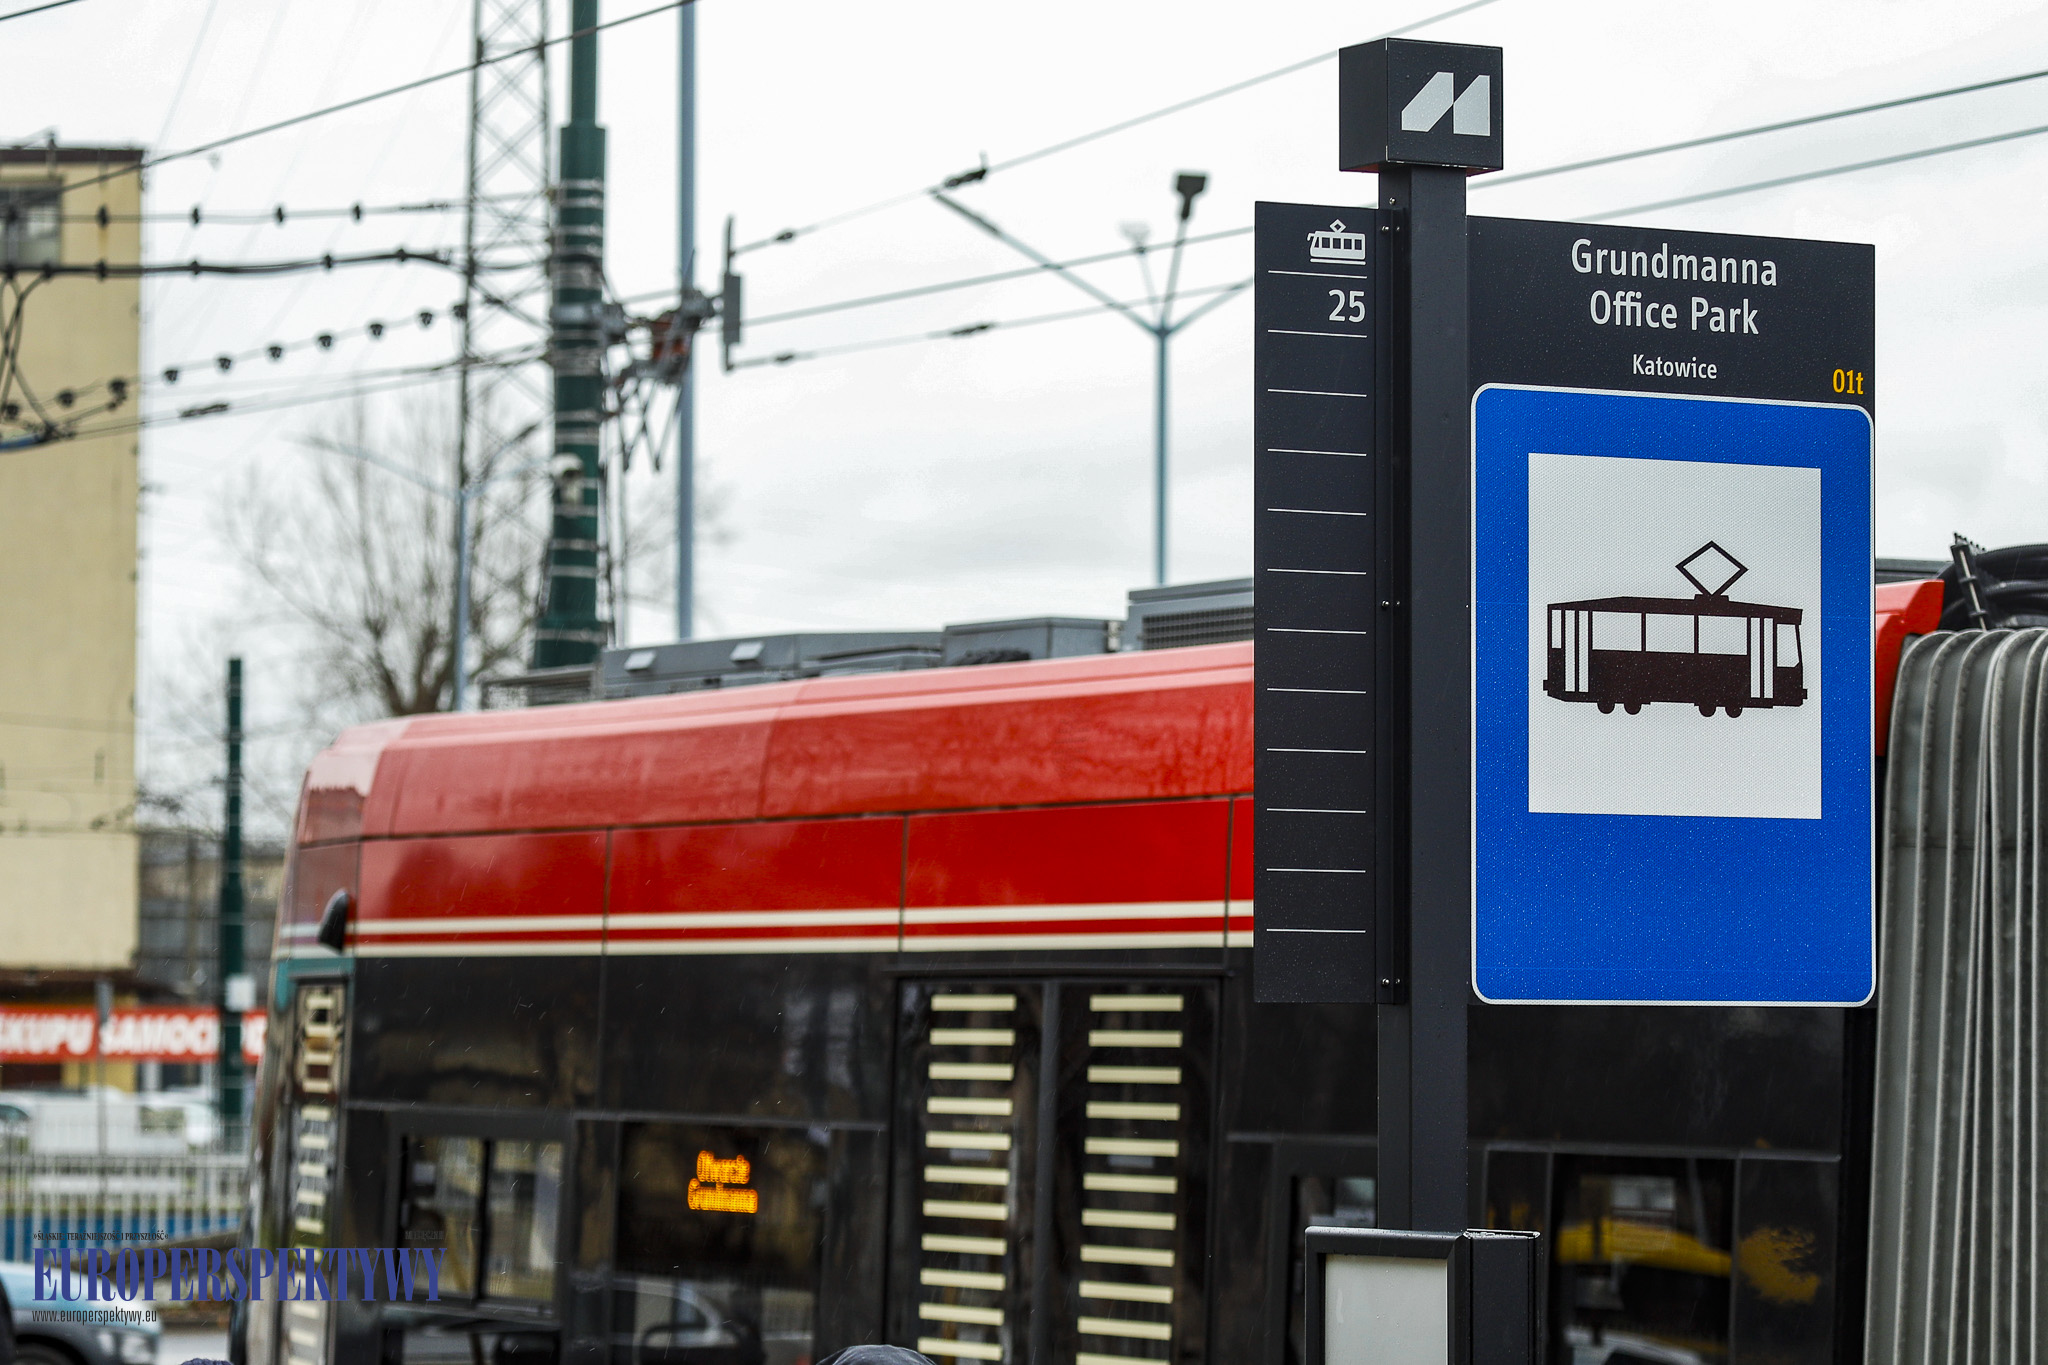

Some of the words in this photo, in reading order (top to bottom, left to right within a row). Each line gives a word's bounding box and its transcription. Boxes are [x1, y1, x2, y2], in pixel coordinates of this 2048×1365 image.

[1571, 238, 1777, 286] Grundmanna
[1328, 289, 1366, 323] 25
[1590, 290, 1678, 329] Office
[1691, 296, 1759, 335] Park
[1632, 354, 1718, 379] Katowice
[1832, 368, 1864, 395] 01t
